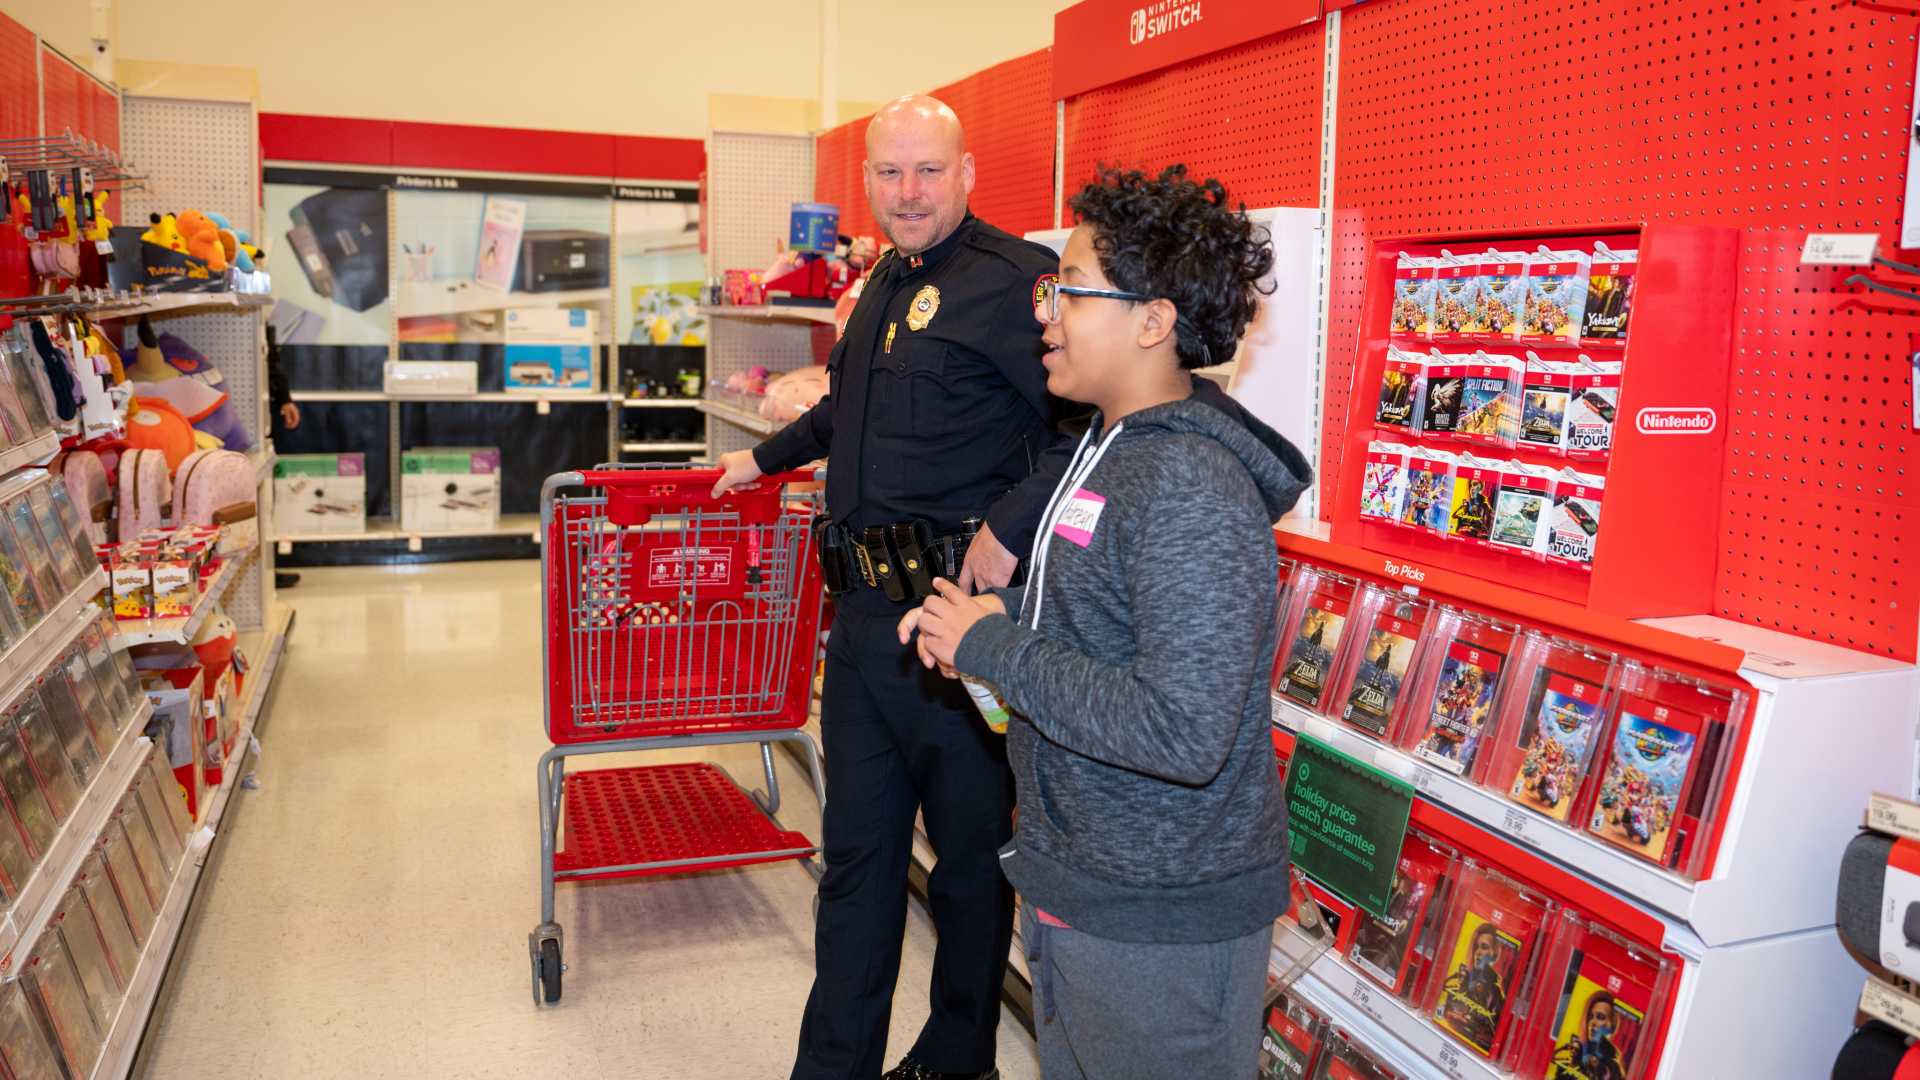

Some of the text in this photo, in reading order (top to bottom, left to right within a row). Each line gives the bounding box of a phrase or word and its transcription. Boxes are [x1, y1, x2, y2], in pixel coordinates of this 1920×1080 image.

[1147, 2, 1201, 38] SWITCH
[396, 175, 433, 187] Printers
[443, 178, 459, 188] Ink
[619, 187, 653, 198] Printers
[661, 189, 676, 199] Ink
[1482, 379, 1505, 392] FICTION
[1643, 413, 1709, 428] Nintendo
[1576, 435, 1608, 447] TOUR
[1556, 535, 1583, 546] WELCOME
[1556, 542, 1588, 559] TOUR
[1384, 561, 1425, 582] Top Picks
[1294, 659, 1318, 681] ZELDA
[1358, 684, 1385, 708] ZELDA
[1294, 780, 1357, 825] holiday price
[1290, 800, 1376, 856] match guarantee
